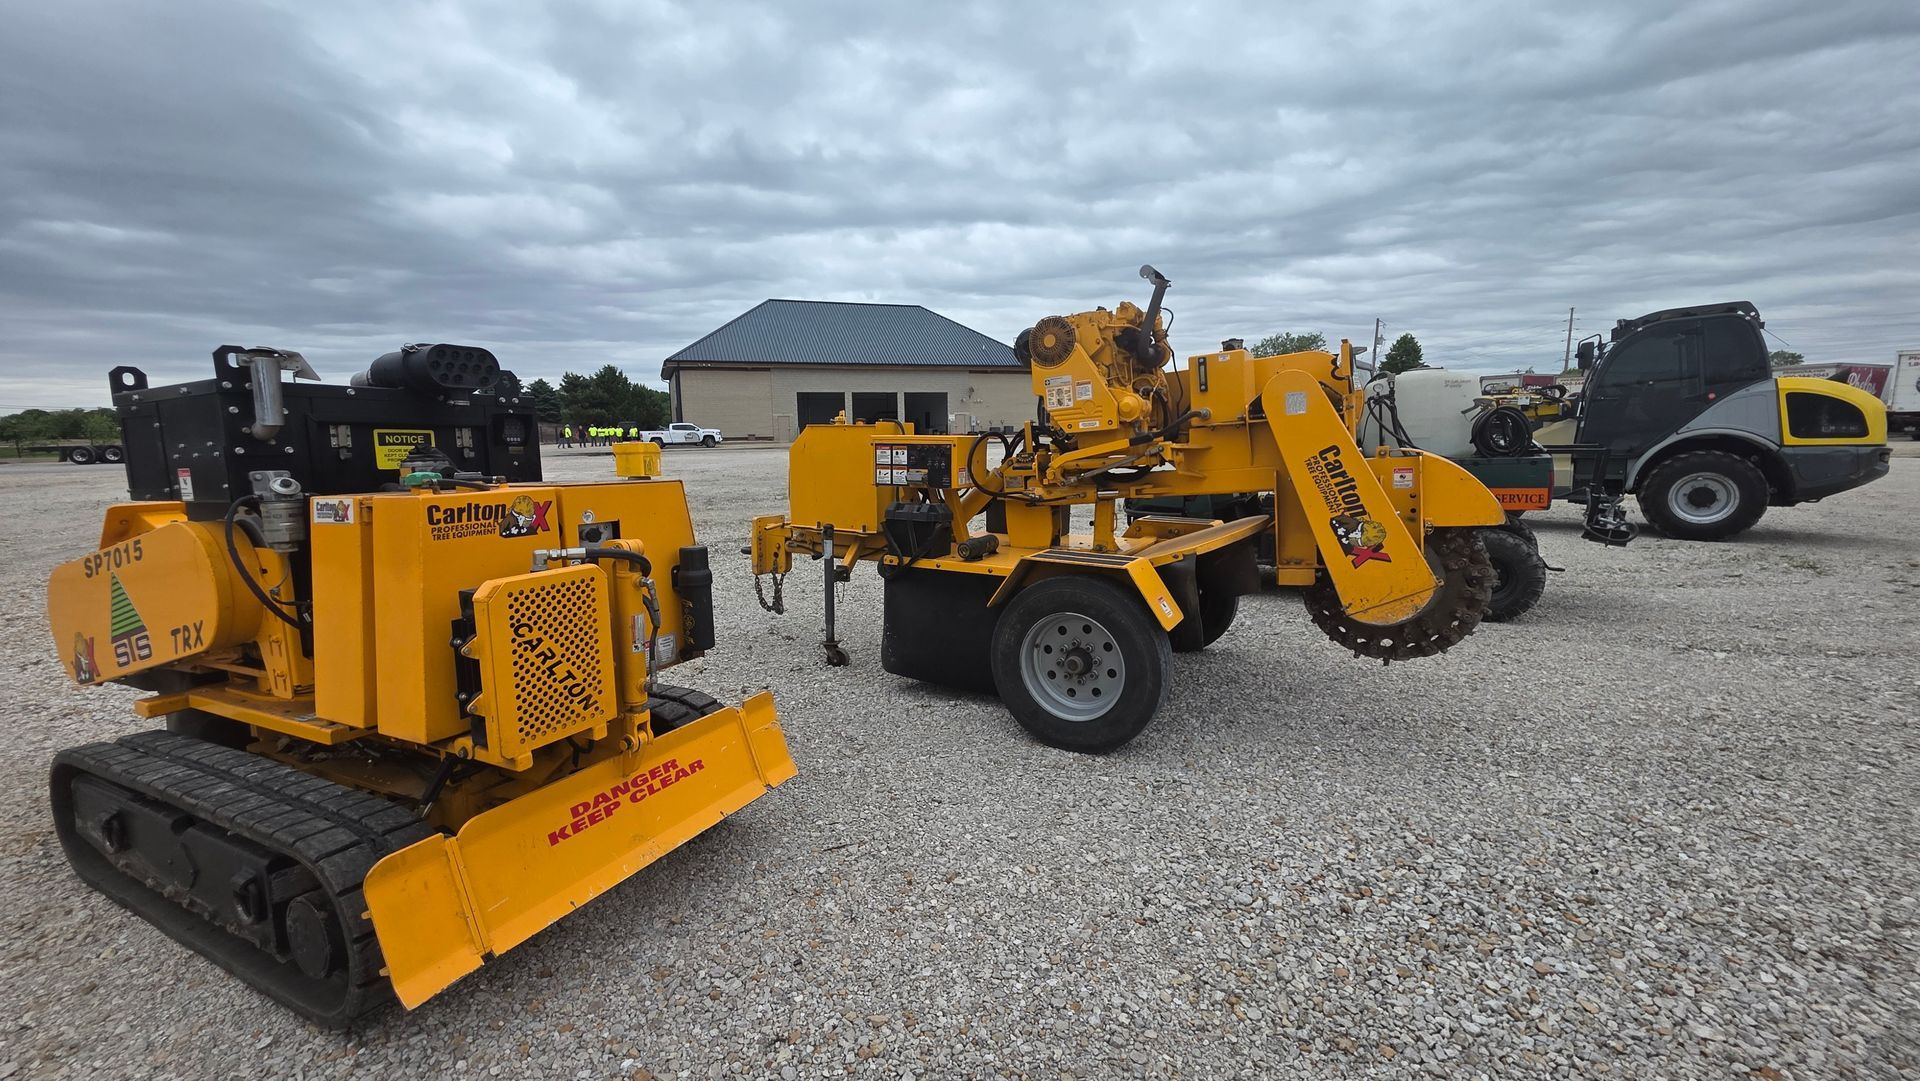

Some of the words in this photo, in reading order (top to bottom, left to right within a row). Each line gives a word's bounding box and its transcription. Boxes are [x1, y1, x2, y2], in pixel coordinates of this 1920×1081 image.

[385, 435, 425, 444] NOTICE
[1304, 458, 1316, 475] TREE
[1312, 474, 1338, 514] EQUIPMENT
[1310, 455, 1345, 513] PROFESSIONAL
[1318, 444, 1368, 519] Carlton
[1495, 493, 1546, 504] SERVICE
[426, 502, 507, 526] Carlton
[431, 521, 499, 534] PROFESSIONAL
[432, 533, 451, 541] TREE
[452, 528, 497, 539] EQUIPMENT
[84, 539, 143, 579] SP7015
[170, 620, 204, 655] TRX
[513, 622, 598, 711] CARLTON
[547, 801, 621, 847] KEEP
[629, 759, 704, 804] CLEAR
[569, 758, 679, 819] DANGER
